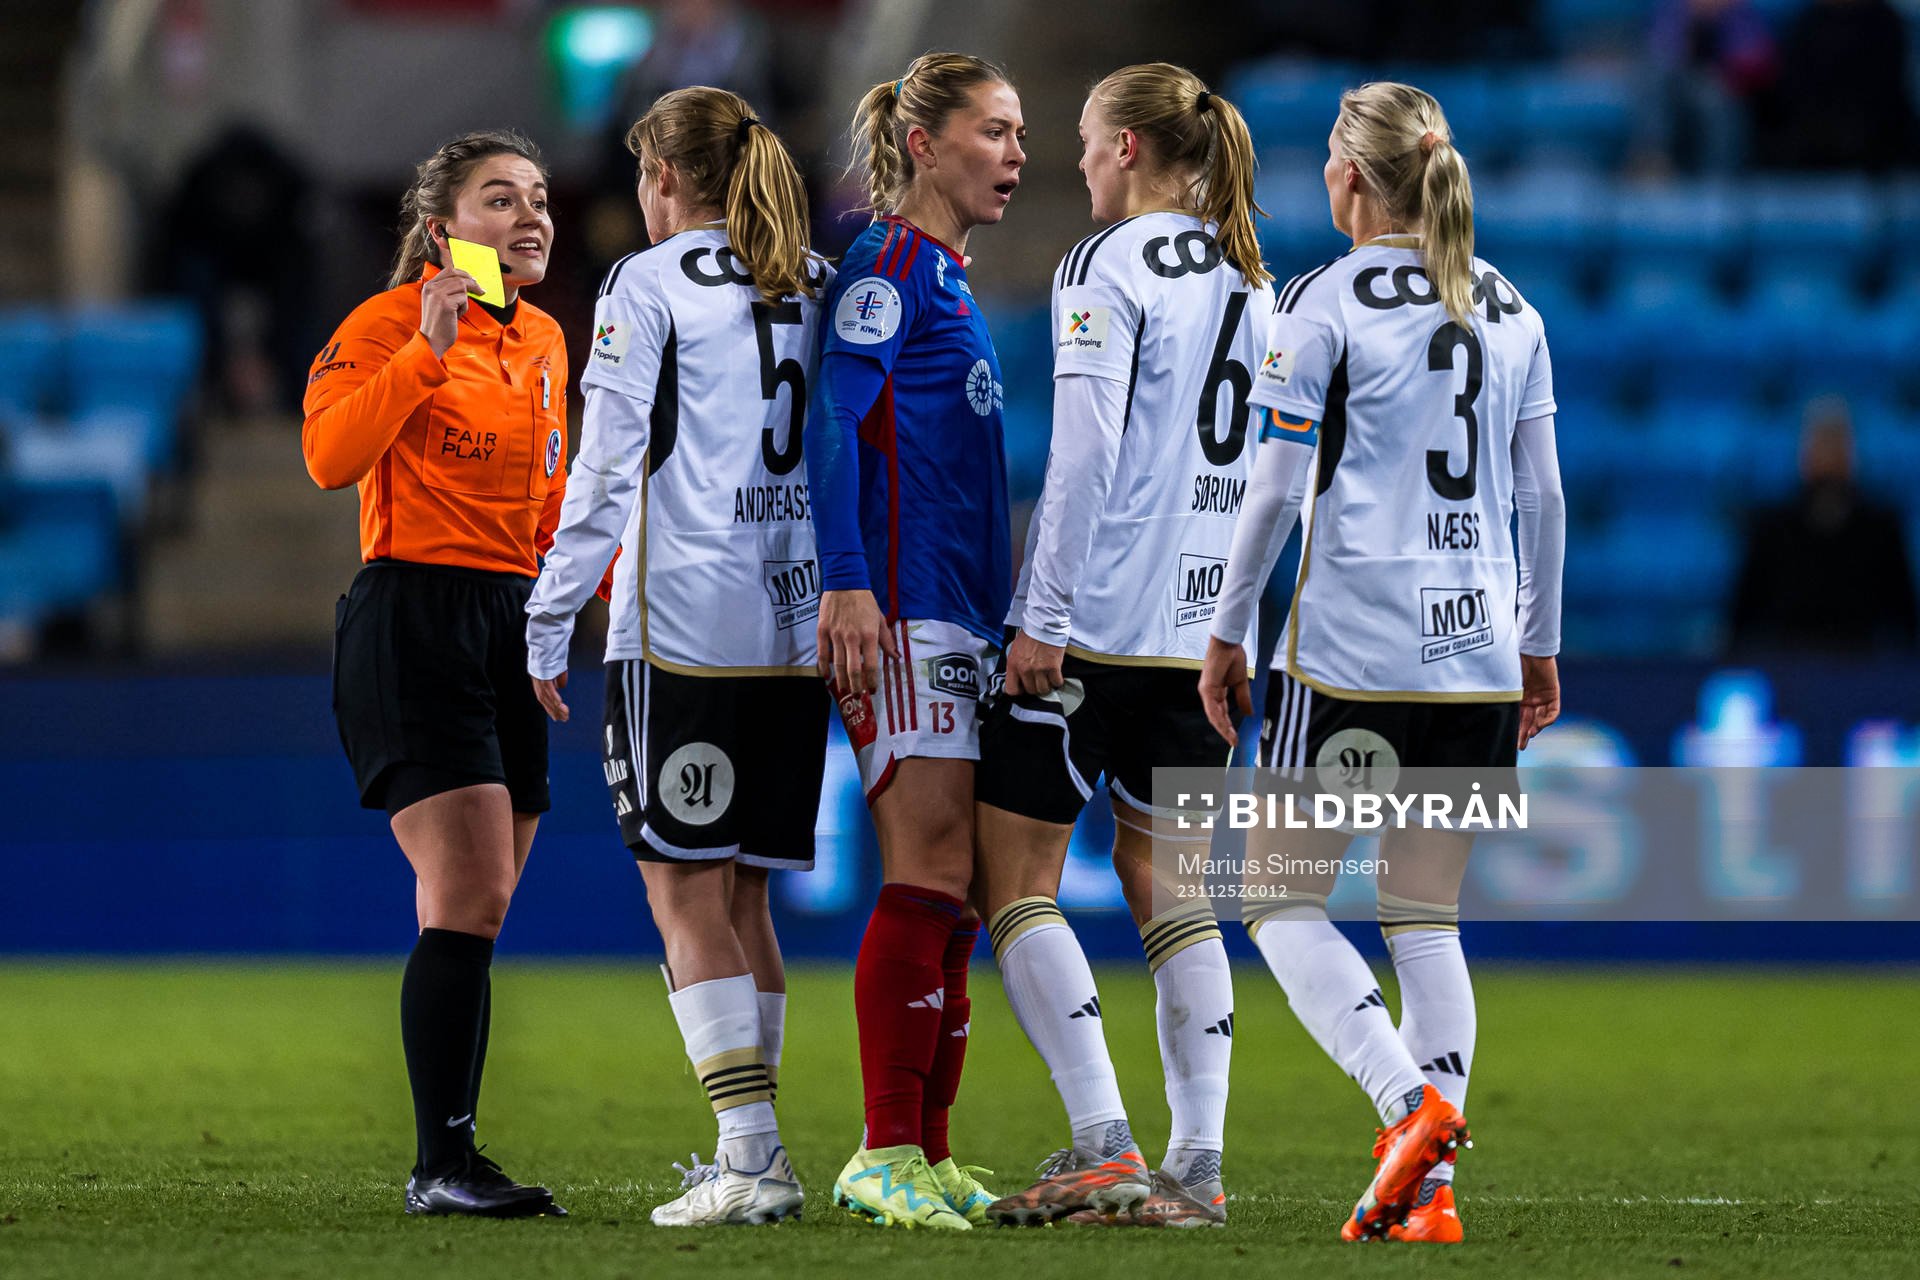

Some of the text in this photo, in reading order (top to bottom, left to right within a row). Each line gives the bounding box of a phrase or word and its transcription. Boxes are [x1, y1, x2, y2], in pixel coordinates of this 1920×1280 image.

[594, 348, 621, 364] Tipping
[1074, 337, 1102, 348] Tipping
[750, 301, 808, 476] 5
[1196, 291, 1252, 467] 6
[1425, 320, 1483, 501] 3
[441, 441, 495, 461] PLAY
[444, 427, 497, 446] FAIR
[734, 484, 812, 523] ANDREASE
[1191, 473, 1247, 514] SØRUM
[1427, 512, 1480, 550] NÆSS
[772, 560, 817, 605] MOT
[1185, 562, 1228, 601] MO
[1180, 609, 1198, 621] SHOW
[1432, 590, 1486, 636] MOT
[1428, 642, 1450, 657] SHOW
[929, 702, 955, 734] 13
